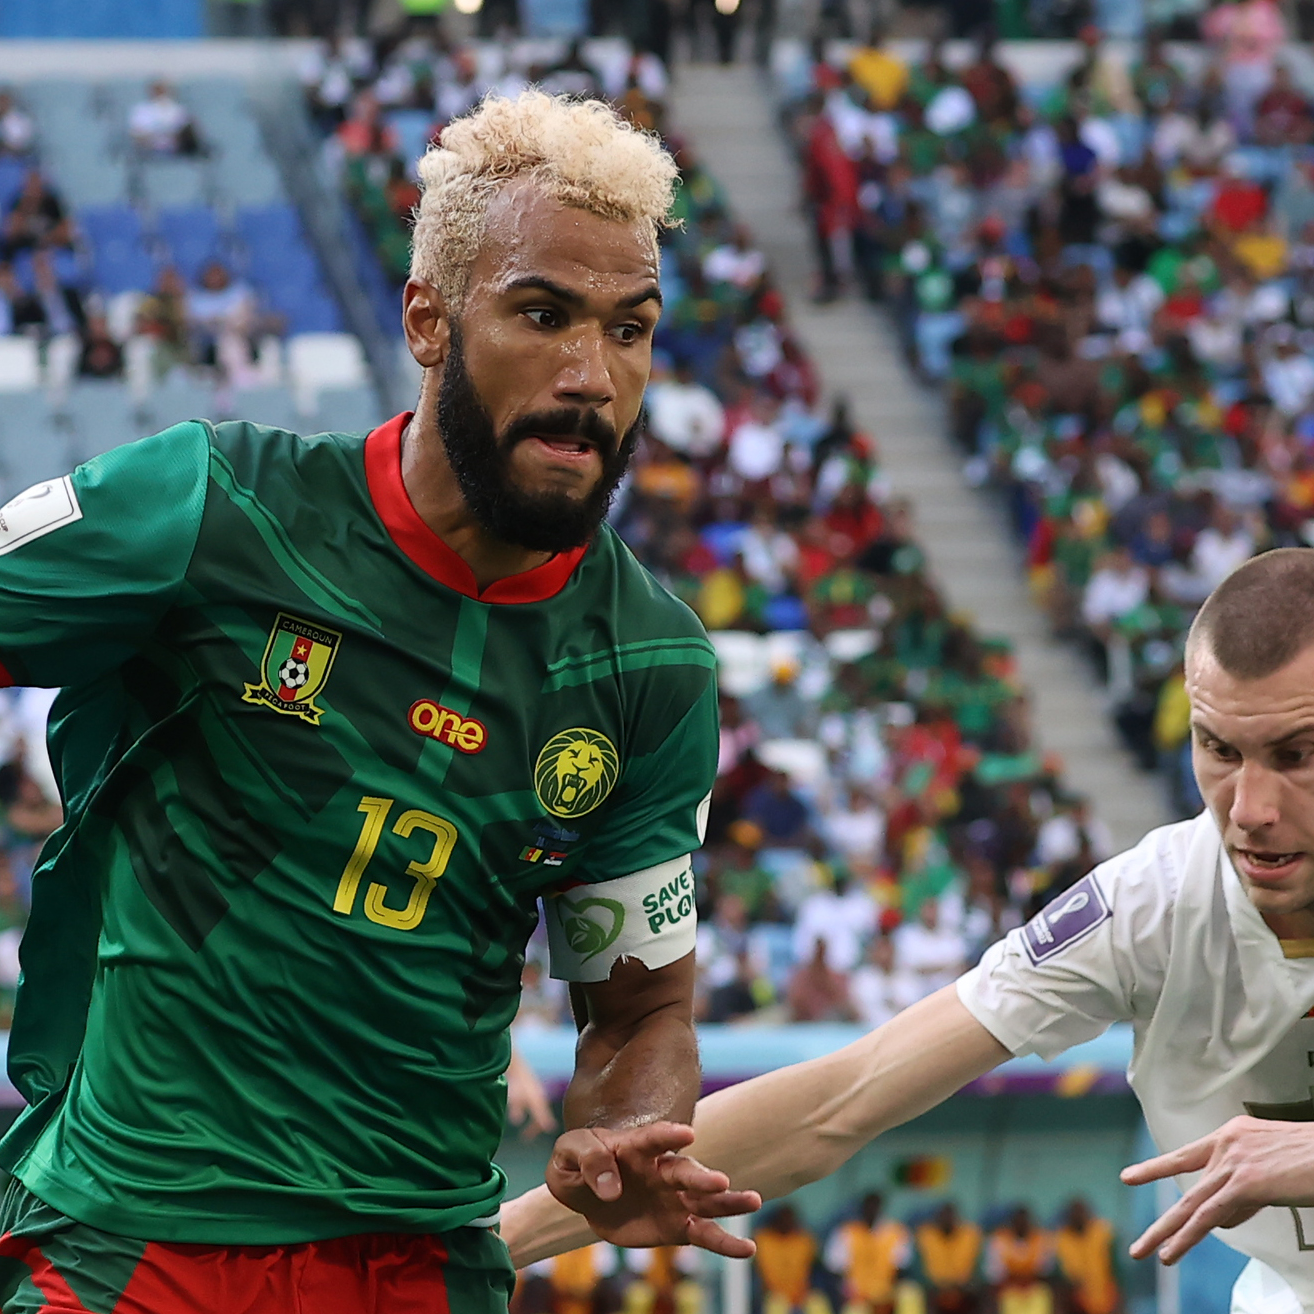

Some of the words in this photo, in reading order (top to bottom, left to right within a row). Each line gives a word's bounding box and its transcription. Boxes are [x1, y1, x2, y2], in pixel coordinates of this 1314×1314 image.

[282, 621, 333, 645] CAMEROUN
[264, 692, 306, 711] FECAFOOT
[411, 702, 484, 751] one
[333, 796, 458, 931] 13
[642, 870, 690, 914] SAVE
